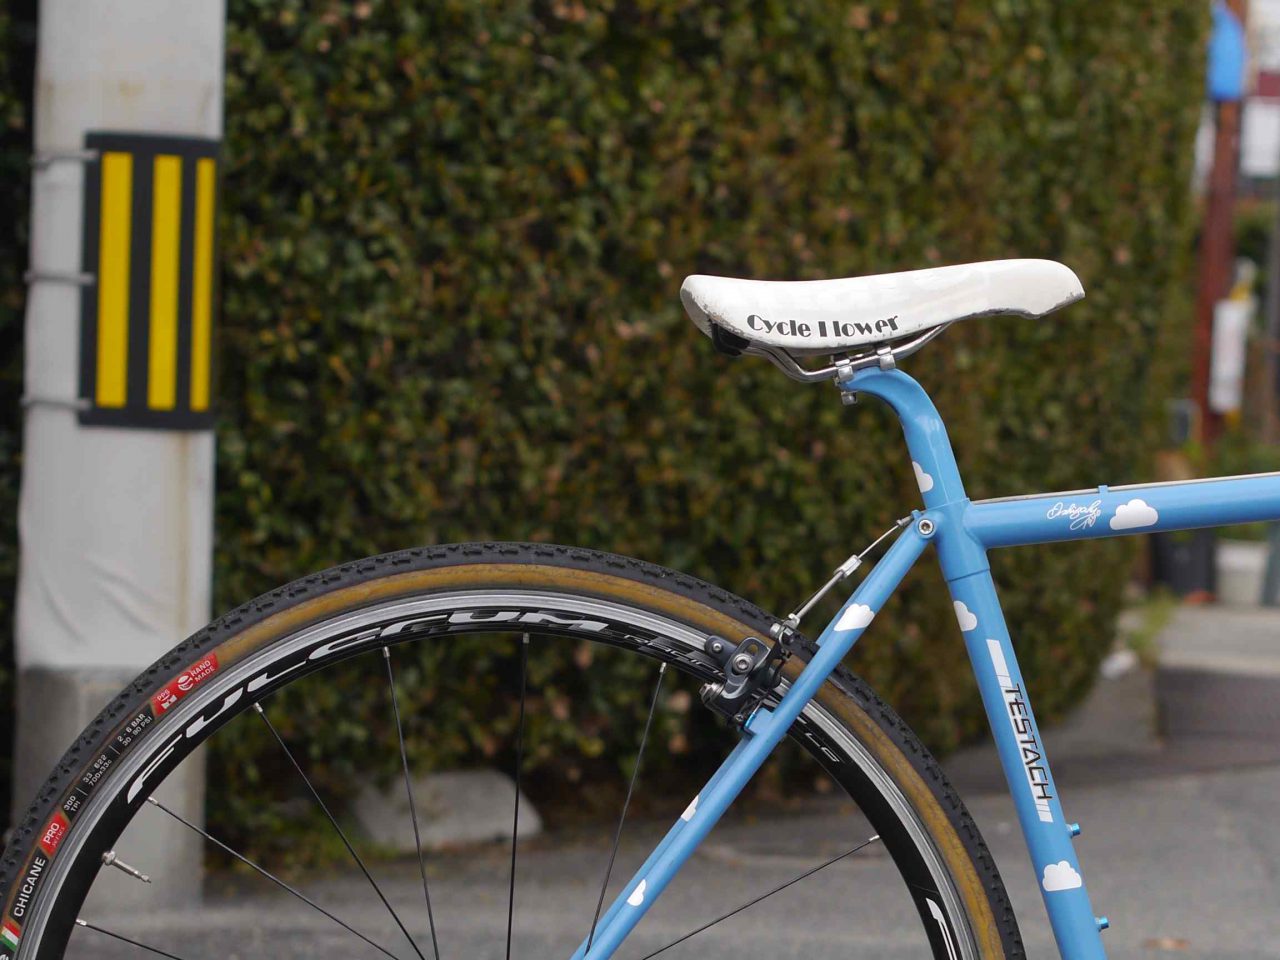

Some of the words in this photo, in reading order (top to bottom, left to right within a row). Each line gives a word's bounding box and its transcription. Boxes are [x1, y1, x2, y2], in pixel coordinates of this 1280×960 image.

[746, 314, 812, 338] Cycle
[189, 660, 212, 677] HAND
[194, 666, 216, 682] MADE
[131, 713, 146, 728] BAR
[140, 716, 153, 728] PSI
[1004, 683, 1052, 800] TESTACH
[83, 772, 93, 783] 33
[63, 795, 76, 811] 300
[70, 801, 81, 812] TPI
[43, 822, 60, 844] PRO
[13, 856, 46, 918] CHICANE
